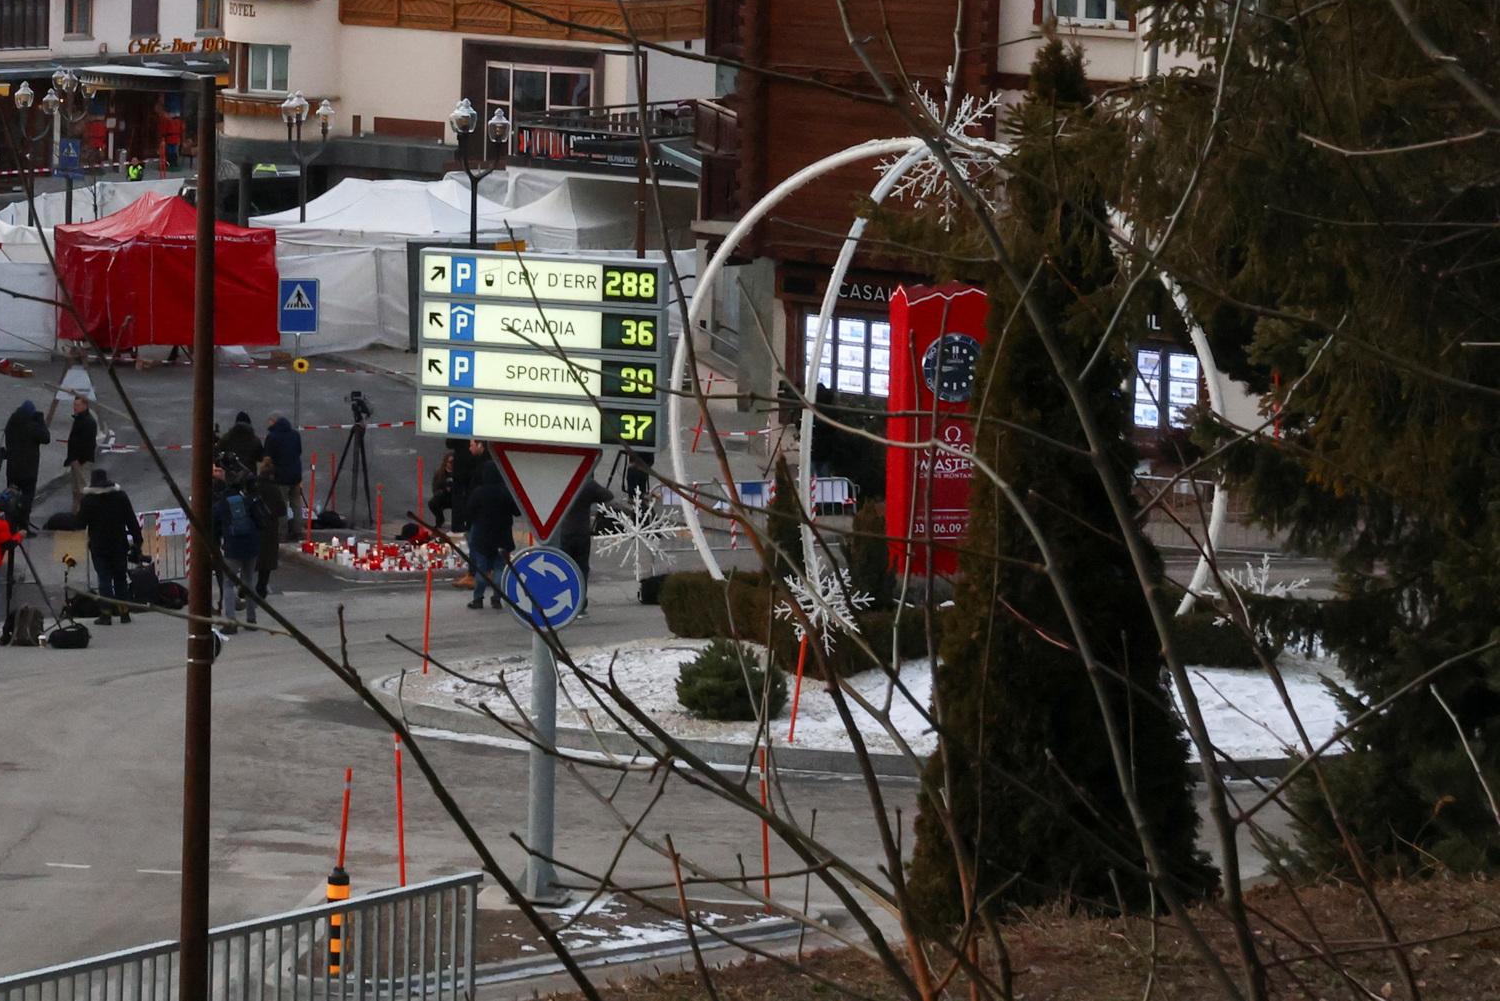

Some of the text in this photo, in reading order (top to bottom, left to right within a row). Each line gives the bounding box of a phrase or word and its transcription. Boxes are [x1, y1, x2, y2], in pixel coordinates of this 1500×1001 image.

[229, 2, 256, 17] HOTEL
[201, 36, 230, 55] 190
[456, 263, 656, 299] P CRY D'ERR 288
[500, 316, 576, 337] SCANDIA
[620, 319, 654, 347] 36
[454, 357, 470, 382] P
[505, 364, 590, 384] SPORTING
[503, 411, 594, 433] RHODANIA
[619, 414, 654, 441] 37
